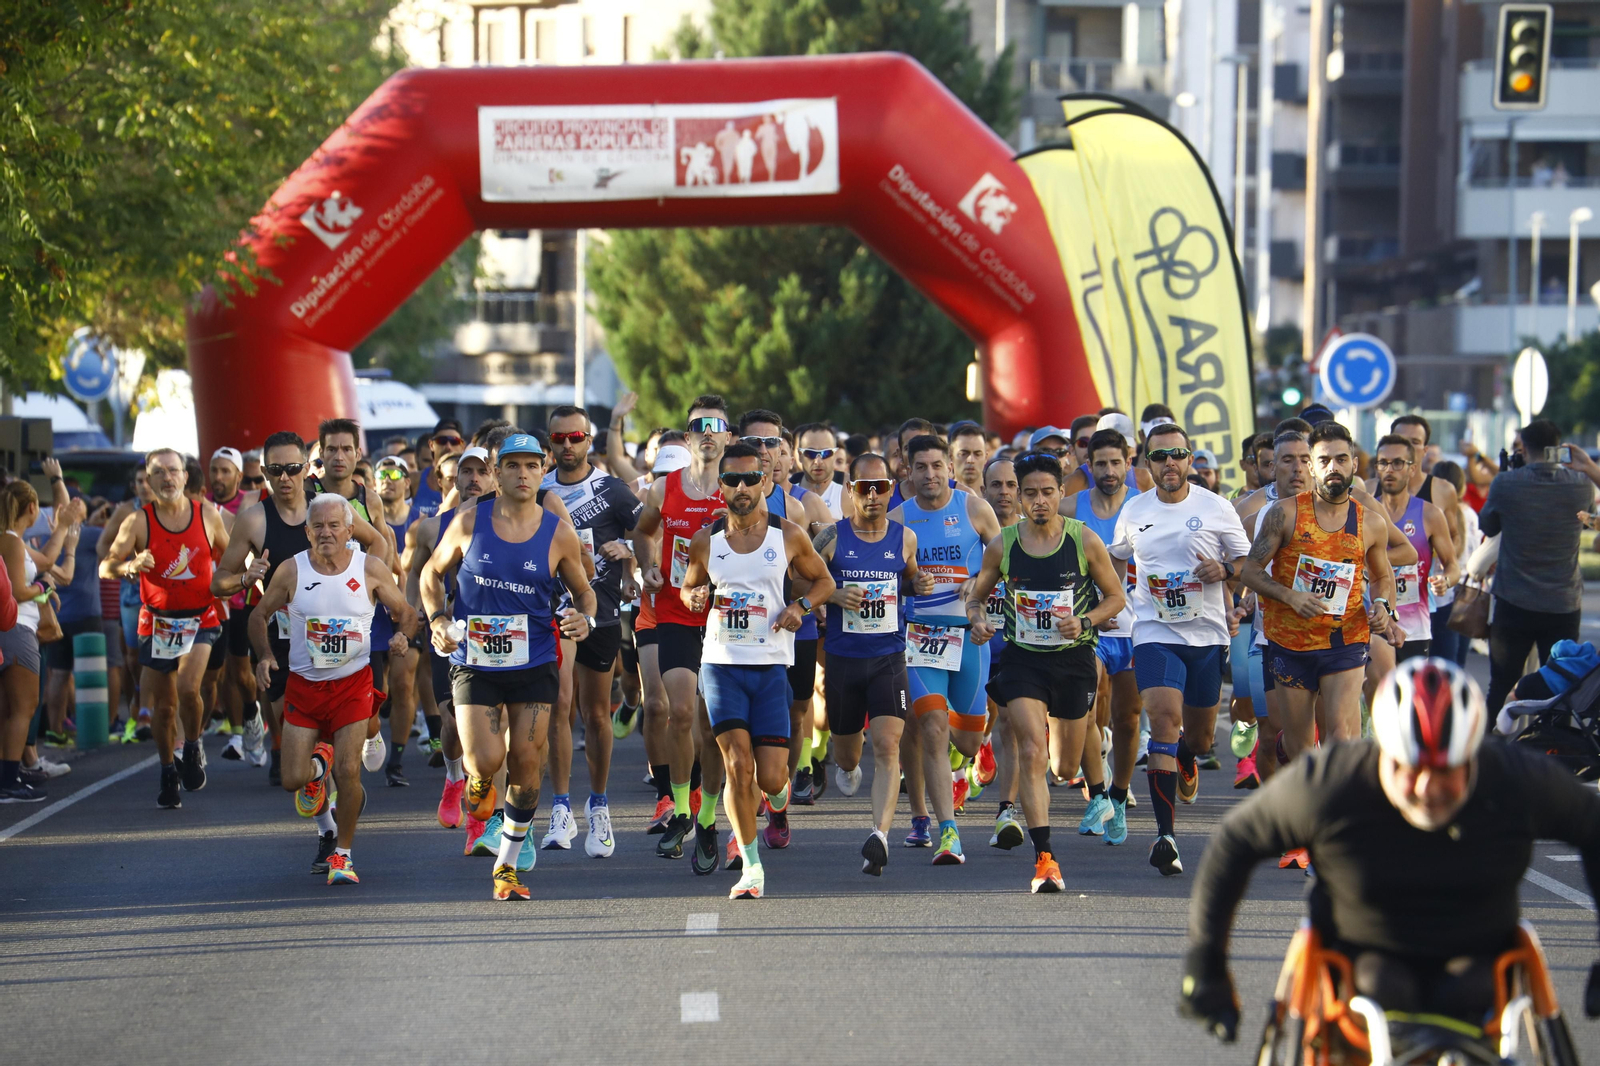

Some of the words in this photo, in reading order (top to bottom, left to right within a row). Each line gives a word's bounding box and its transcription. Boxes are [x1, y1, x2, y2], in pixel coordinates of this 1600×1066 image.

[494, 120, 560, 135] CIRCUITO
[563, 118, 648, 134] PROVINCIAL
[494, 134, 577, 151] CARRERAS
[580, 131, 669, 150] POPULARES
[888, 164, 963, 238] Diputación
[958, 231, 981, 253] de
[979, 247, 1035, 304] Córdoba
[289, 246, 364, 318] Diputación
[361, 229, 381, 249] de
[377, 175, 435, 230] Córdoba
[596, 495, 606, 504] AL
[580, 500, 611, 522] VELETA
[841, 569, 898, 580] TROTASIERRA
[473, 574, 536, 595] TROTASIERRA
[1311, 577, 1336, 599] 130
[1165, 589, 1186, 608] 95
[860, 600, 885, 619] 318
[726, 610, 749, 629] 113
[1035, 611, 1051, 630] 18
[168, 632, 184, 647] 74
[321, 635, 347, 653] 391
[483, 635, 512, 654] 395
[919, 637, 948, 656] 287
